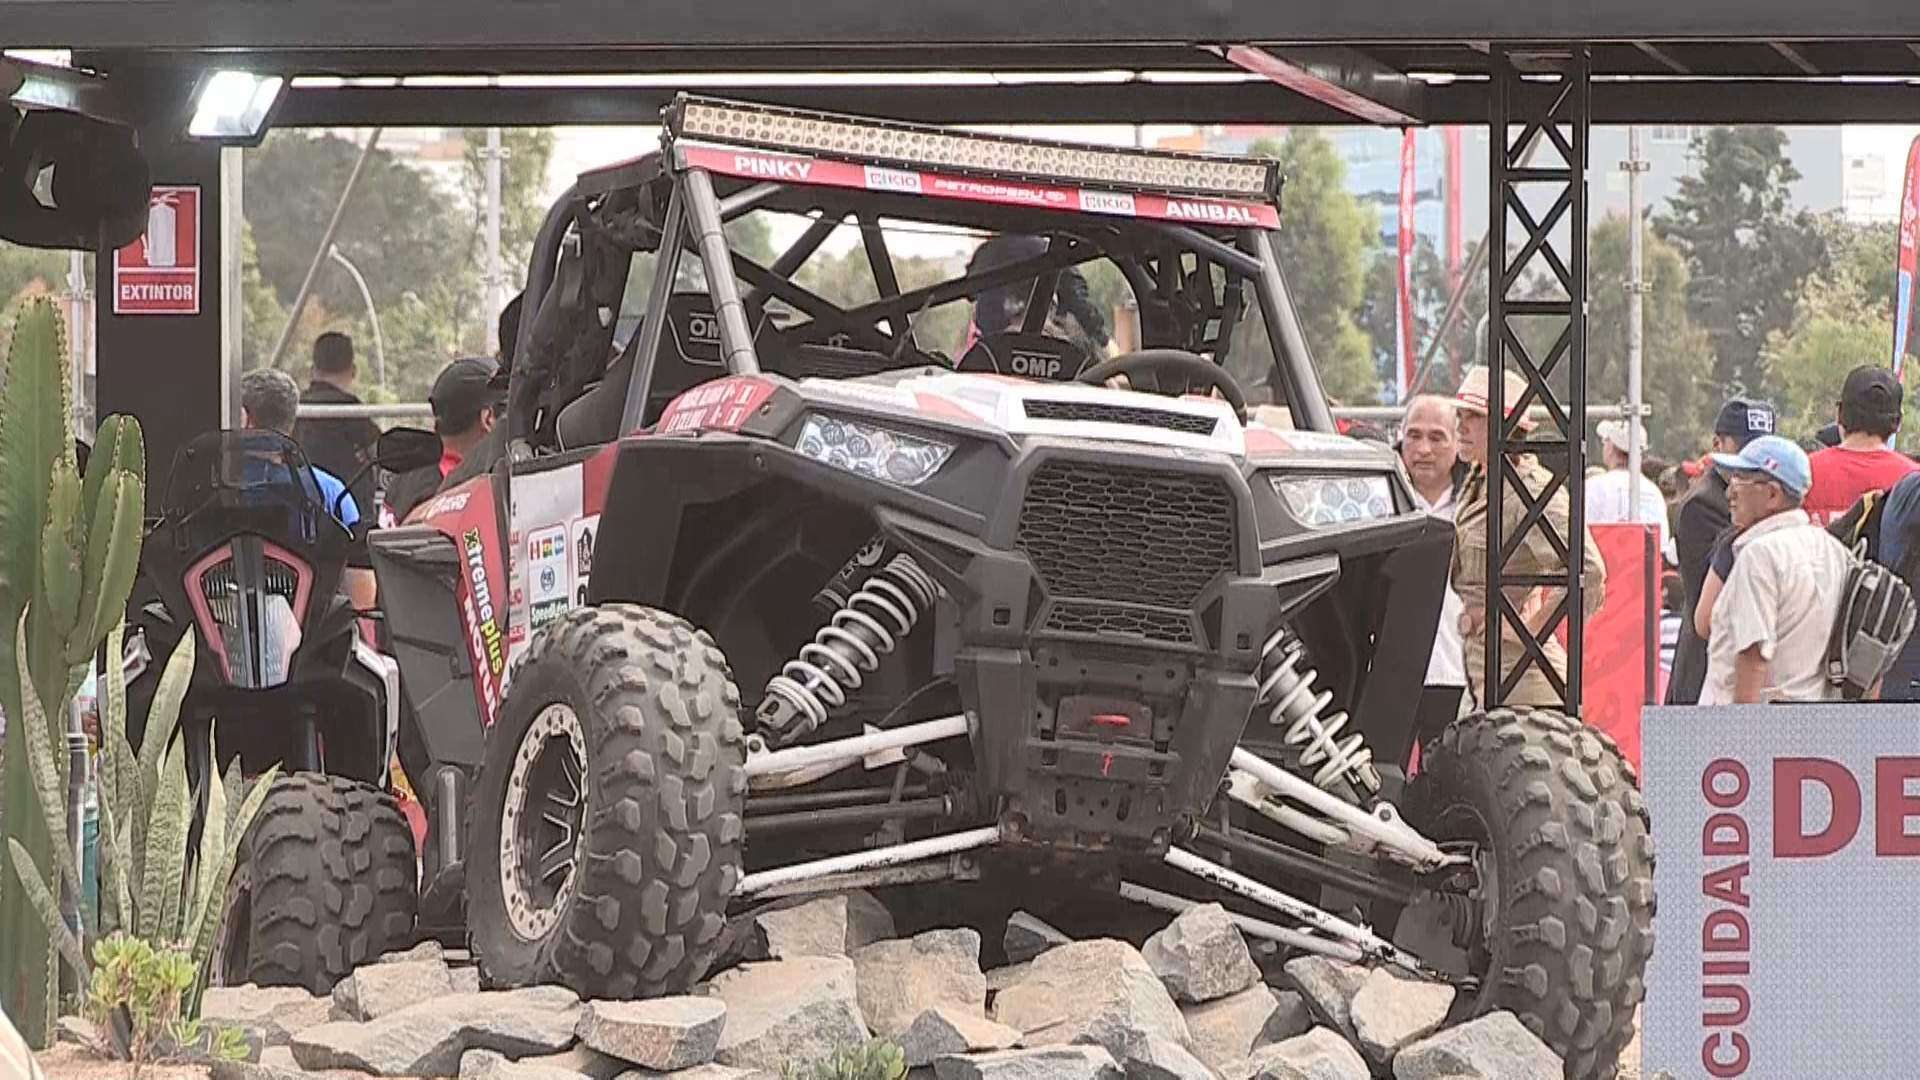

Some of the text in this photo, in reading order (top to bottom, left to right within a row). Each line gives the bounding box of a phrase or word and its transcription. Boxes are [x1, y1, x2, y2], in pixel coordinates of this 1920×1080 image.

[734, 155, 813, 180] PINKY
[1165, 201, 1255, 223] ANIBAL
[121, 284, 193, 301] EXTINTOR
[689, 318, 720, 339] OM
[1011, 356, 1061, 378] OMP
[464, 592, 497, 728] MOTUL
[1701, 757, 1751, 1079] CUIDADO
